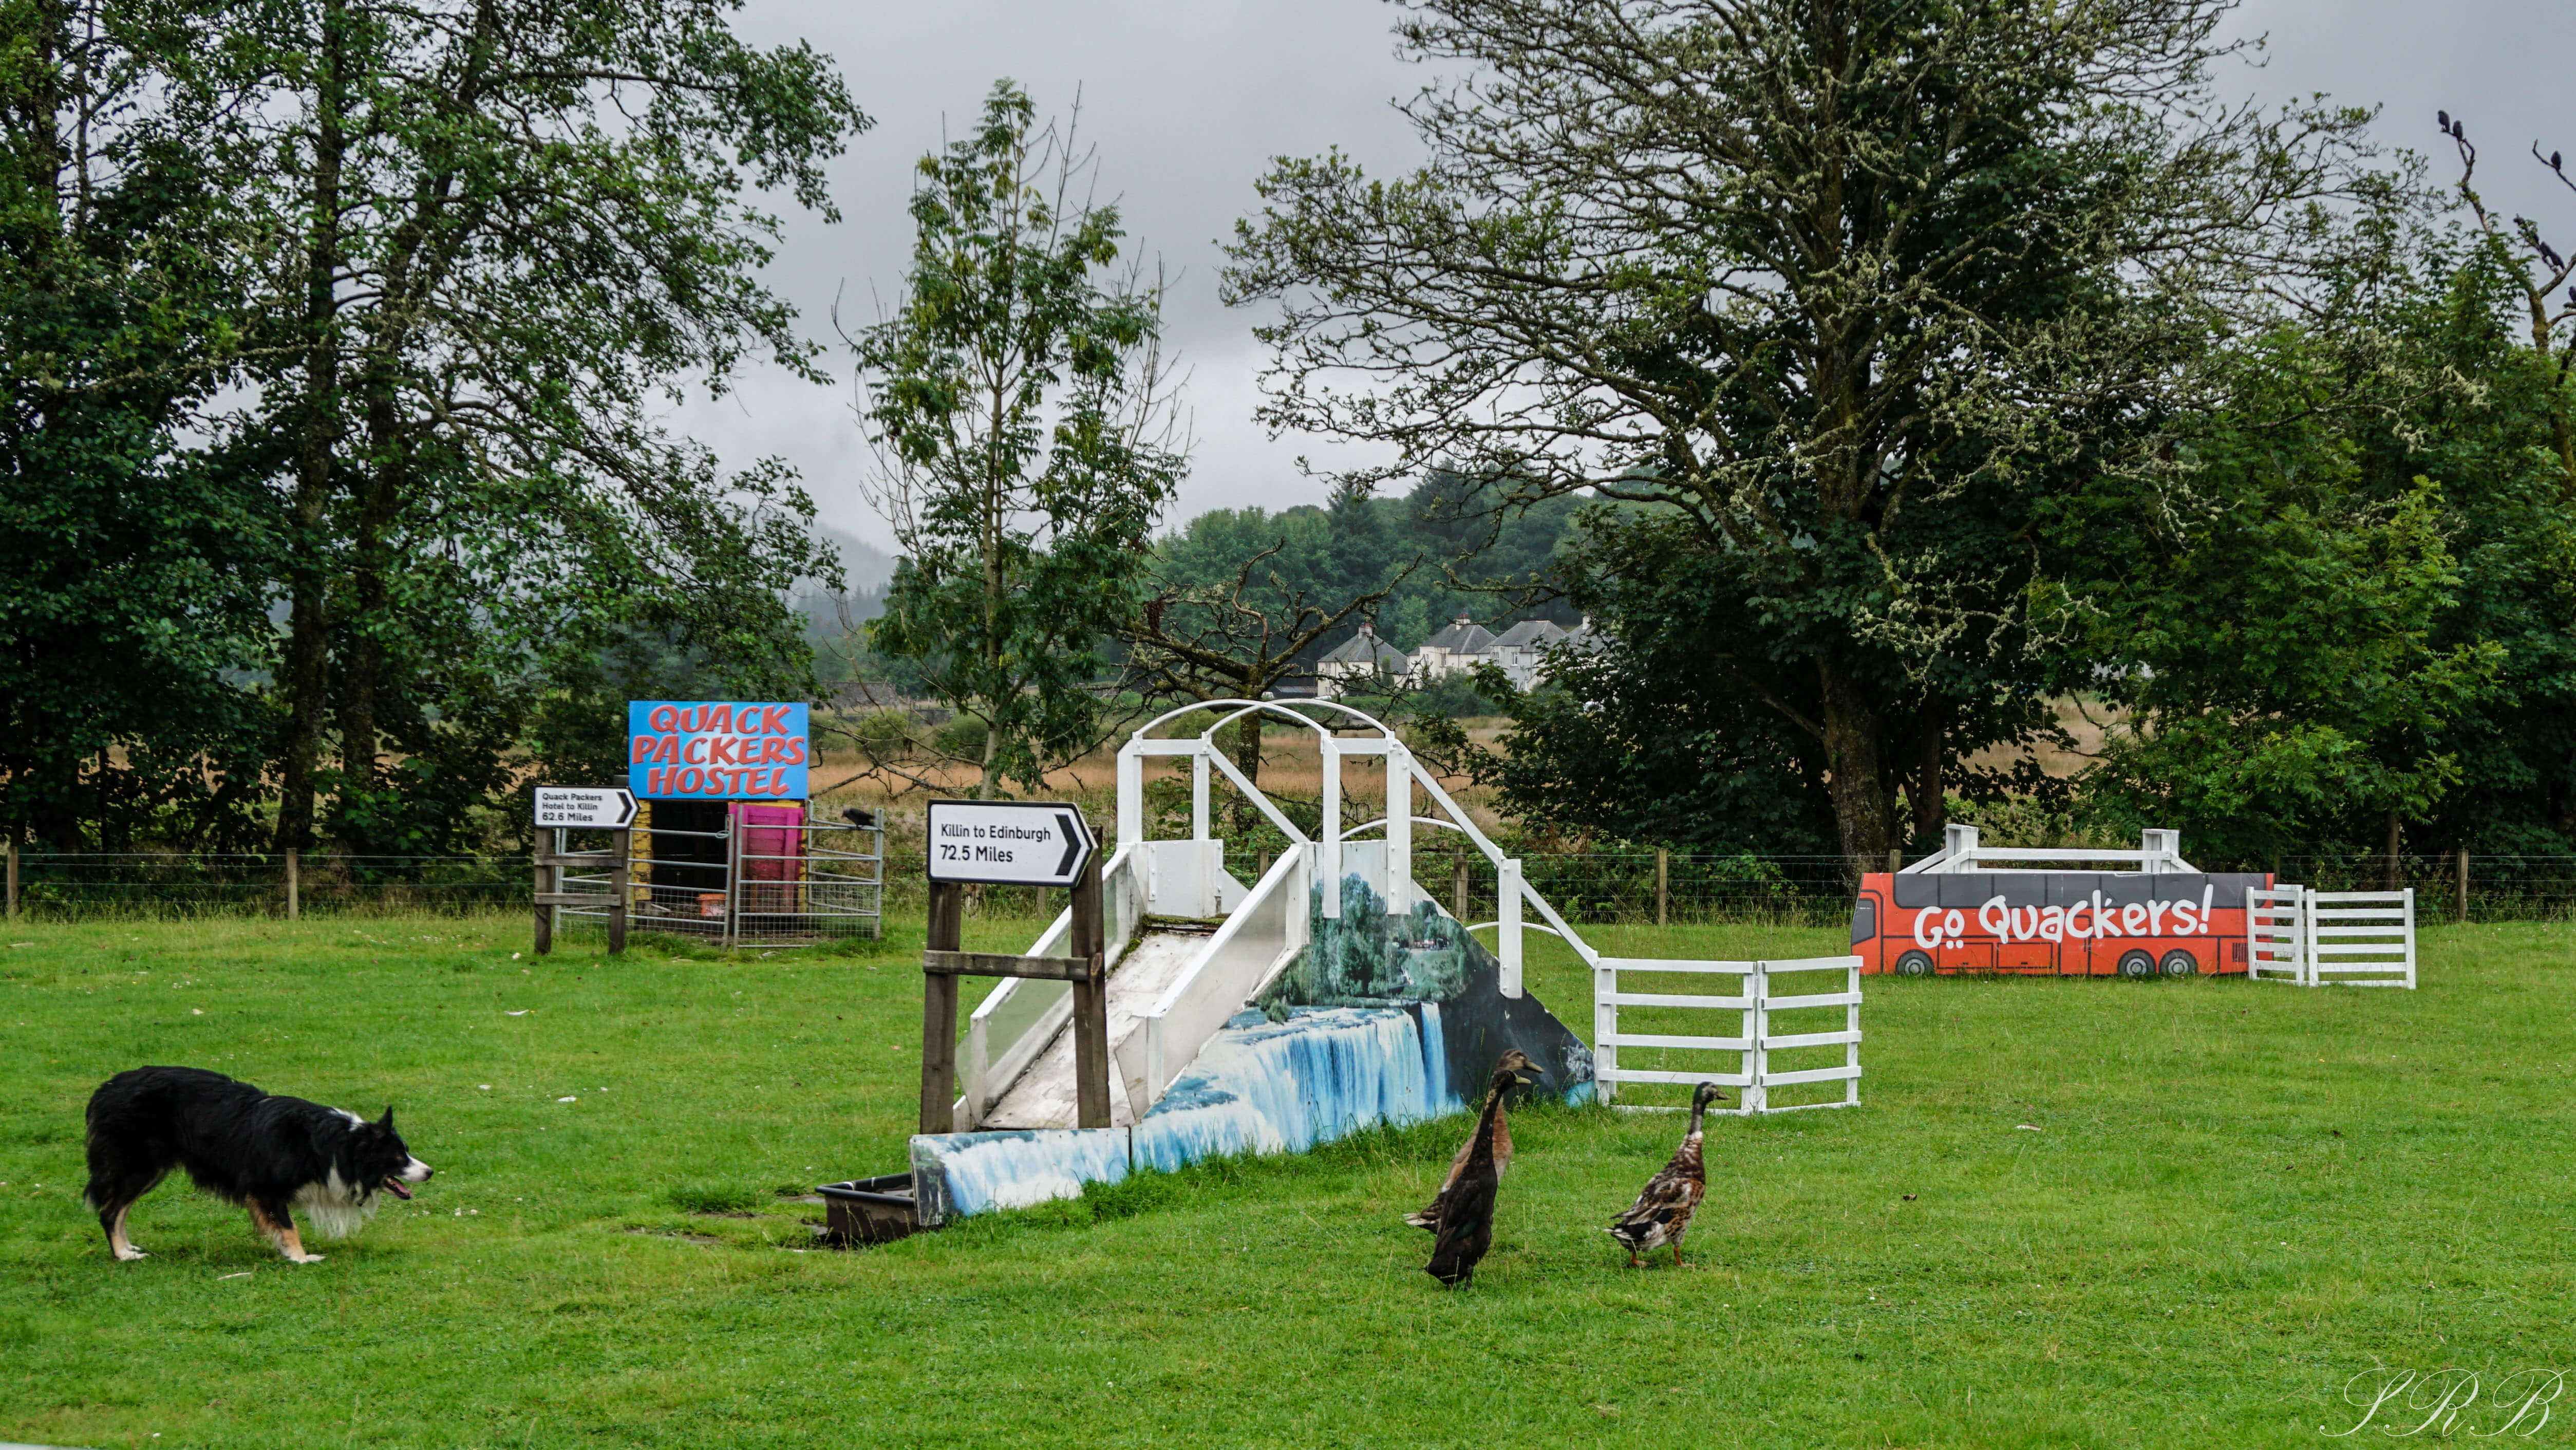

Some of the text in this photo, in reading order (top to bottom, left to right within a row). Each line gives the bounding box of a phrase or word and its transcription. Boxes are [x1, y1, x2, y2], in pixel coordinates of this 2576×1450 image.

[648, 704, 792, 735] QUACK
[632, 735, 805, 766] PACKERS
[648, 765, 790, 796] HOSTEL
[542, 812, 564, 821] 62.6
[941, 824, 1051, 843] Killin to Edinburgh
[940, 844, 1013, 862] 72.5 Miles
